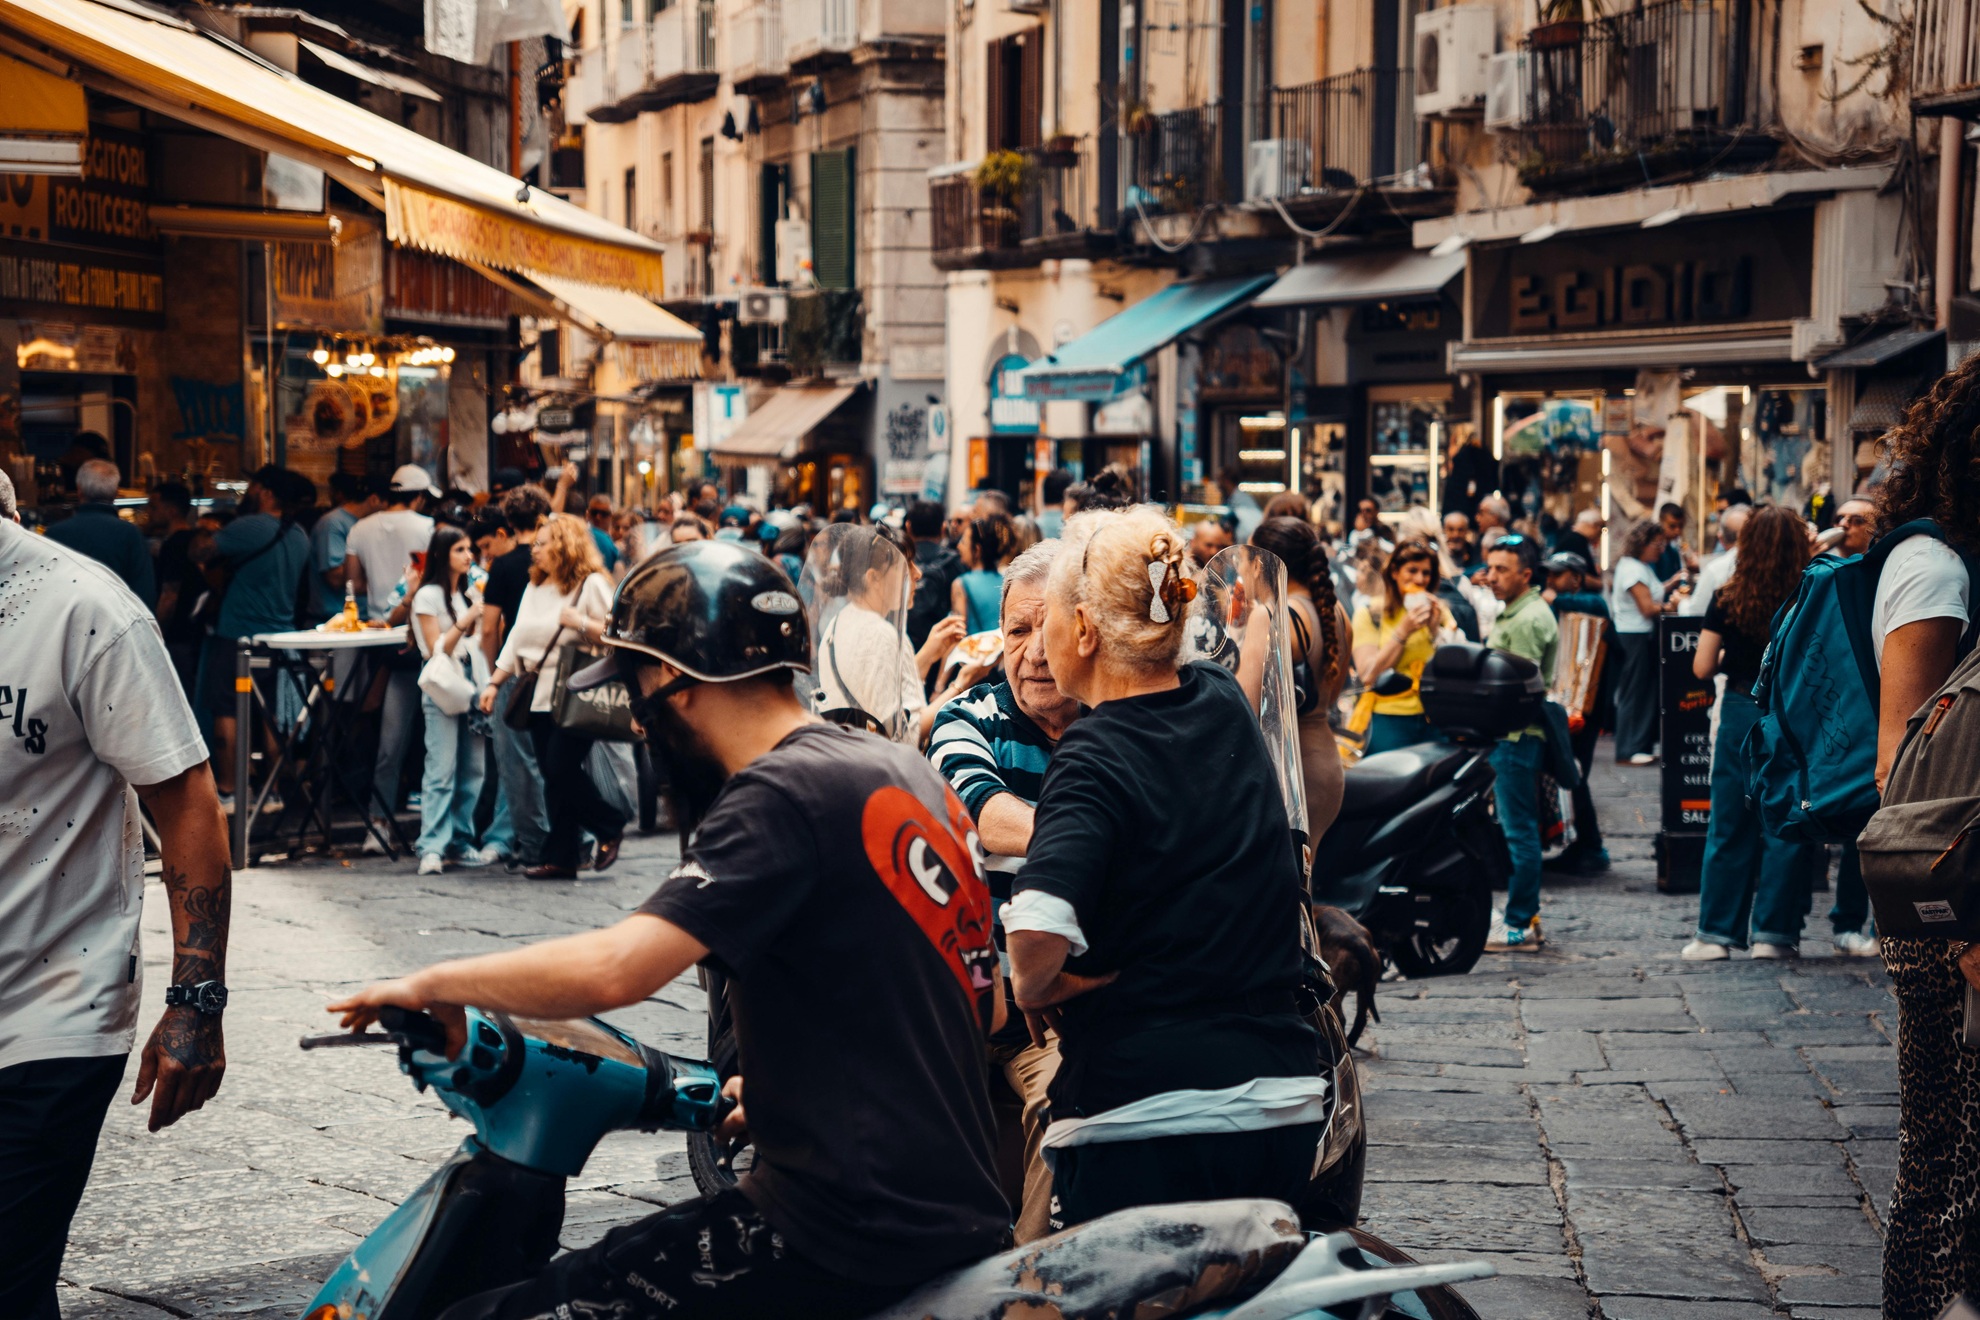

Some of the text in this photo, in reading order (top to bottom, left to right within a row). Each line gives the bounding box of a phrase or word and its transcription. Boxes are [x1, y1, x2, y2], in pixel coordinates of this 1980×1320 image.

[1671, 632, 1699, 652] DR
[1684, 733, 1711, 745] COC
[1680, 753, 1710, 766] CROS
[626, 1271, 678, 1310] SPORT
